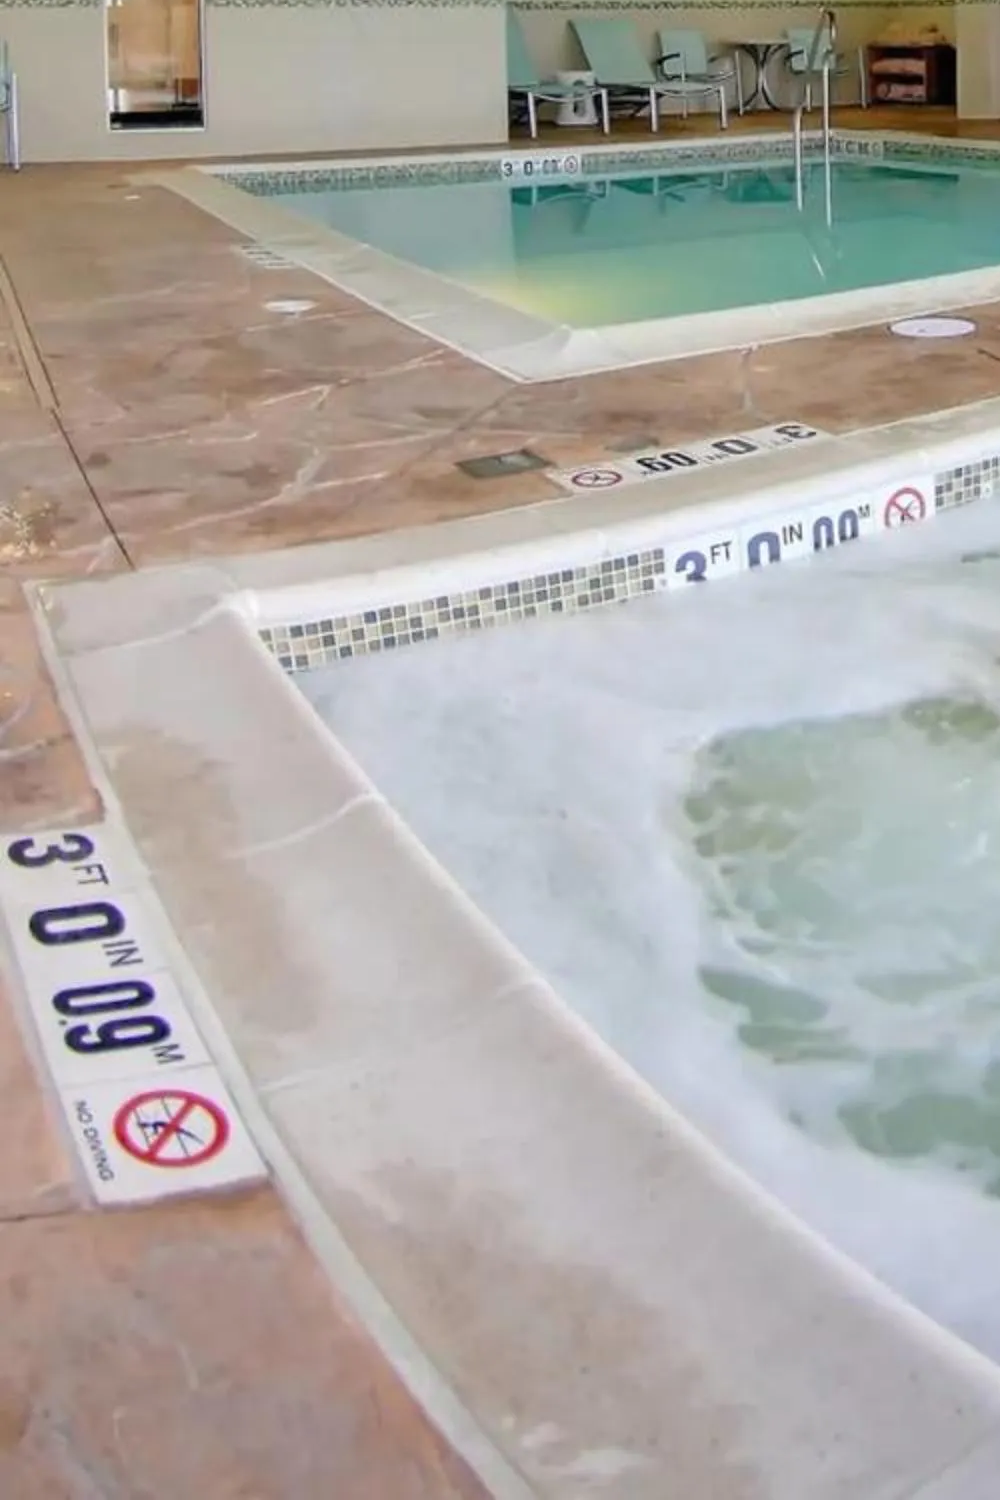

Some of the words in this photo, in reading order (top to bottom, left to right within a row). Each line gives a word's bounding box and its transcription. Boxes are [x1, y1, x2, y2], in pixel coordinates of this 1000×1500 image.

[503, 161, 513, 177] 3
[710, 541, 732, 564] FT
[782, 522, 803, 545] IN
[7, 833, 94, 868] 3
[72, 862, 109, 886] FT
[29, 901, 126, 946] 0
[102, 939, 144, 969] IN
[152, 1043, 185, 1065] M
[74, 1100, 93, 1124] NO
[83, 1127, 115, 1181] DIVING
